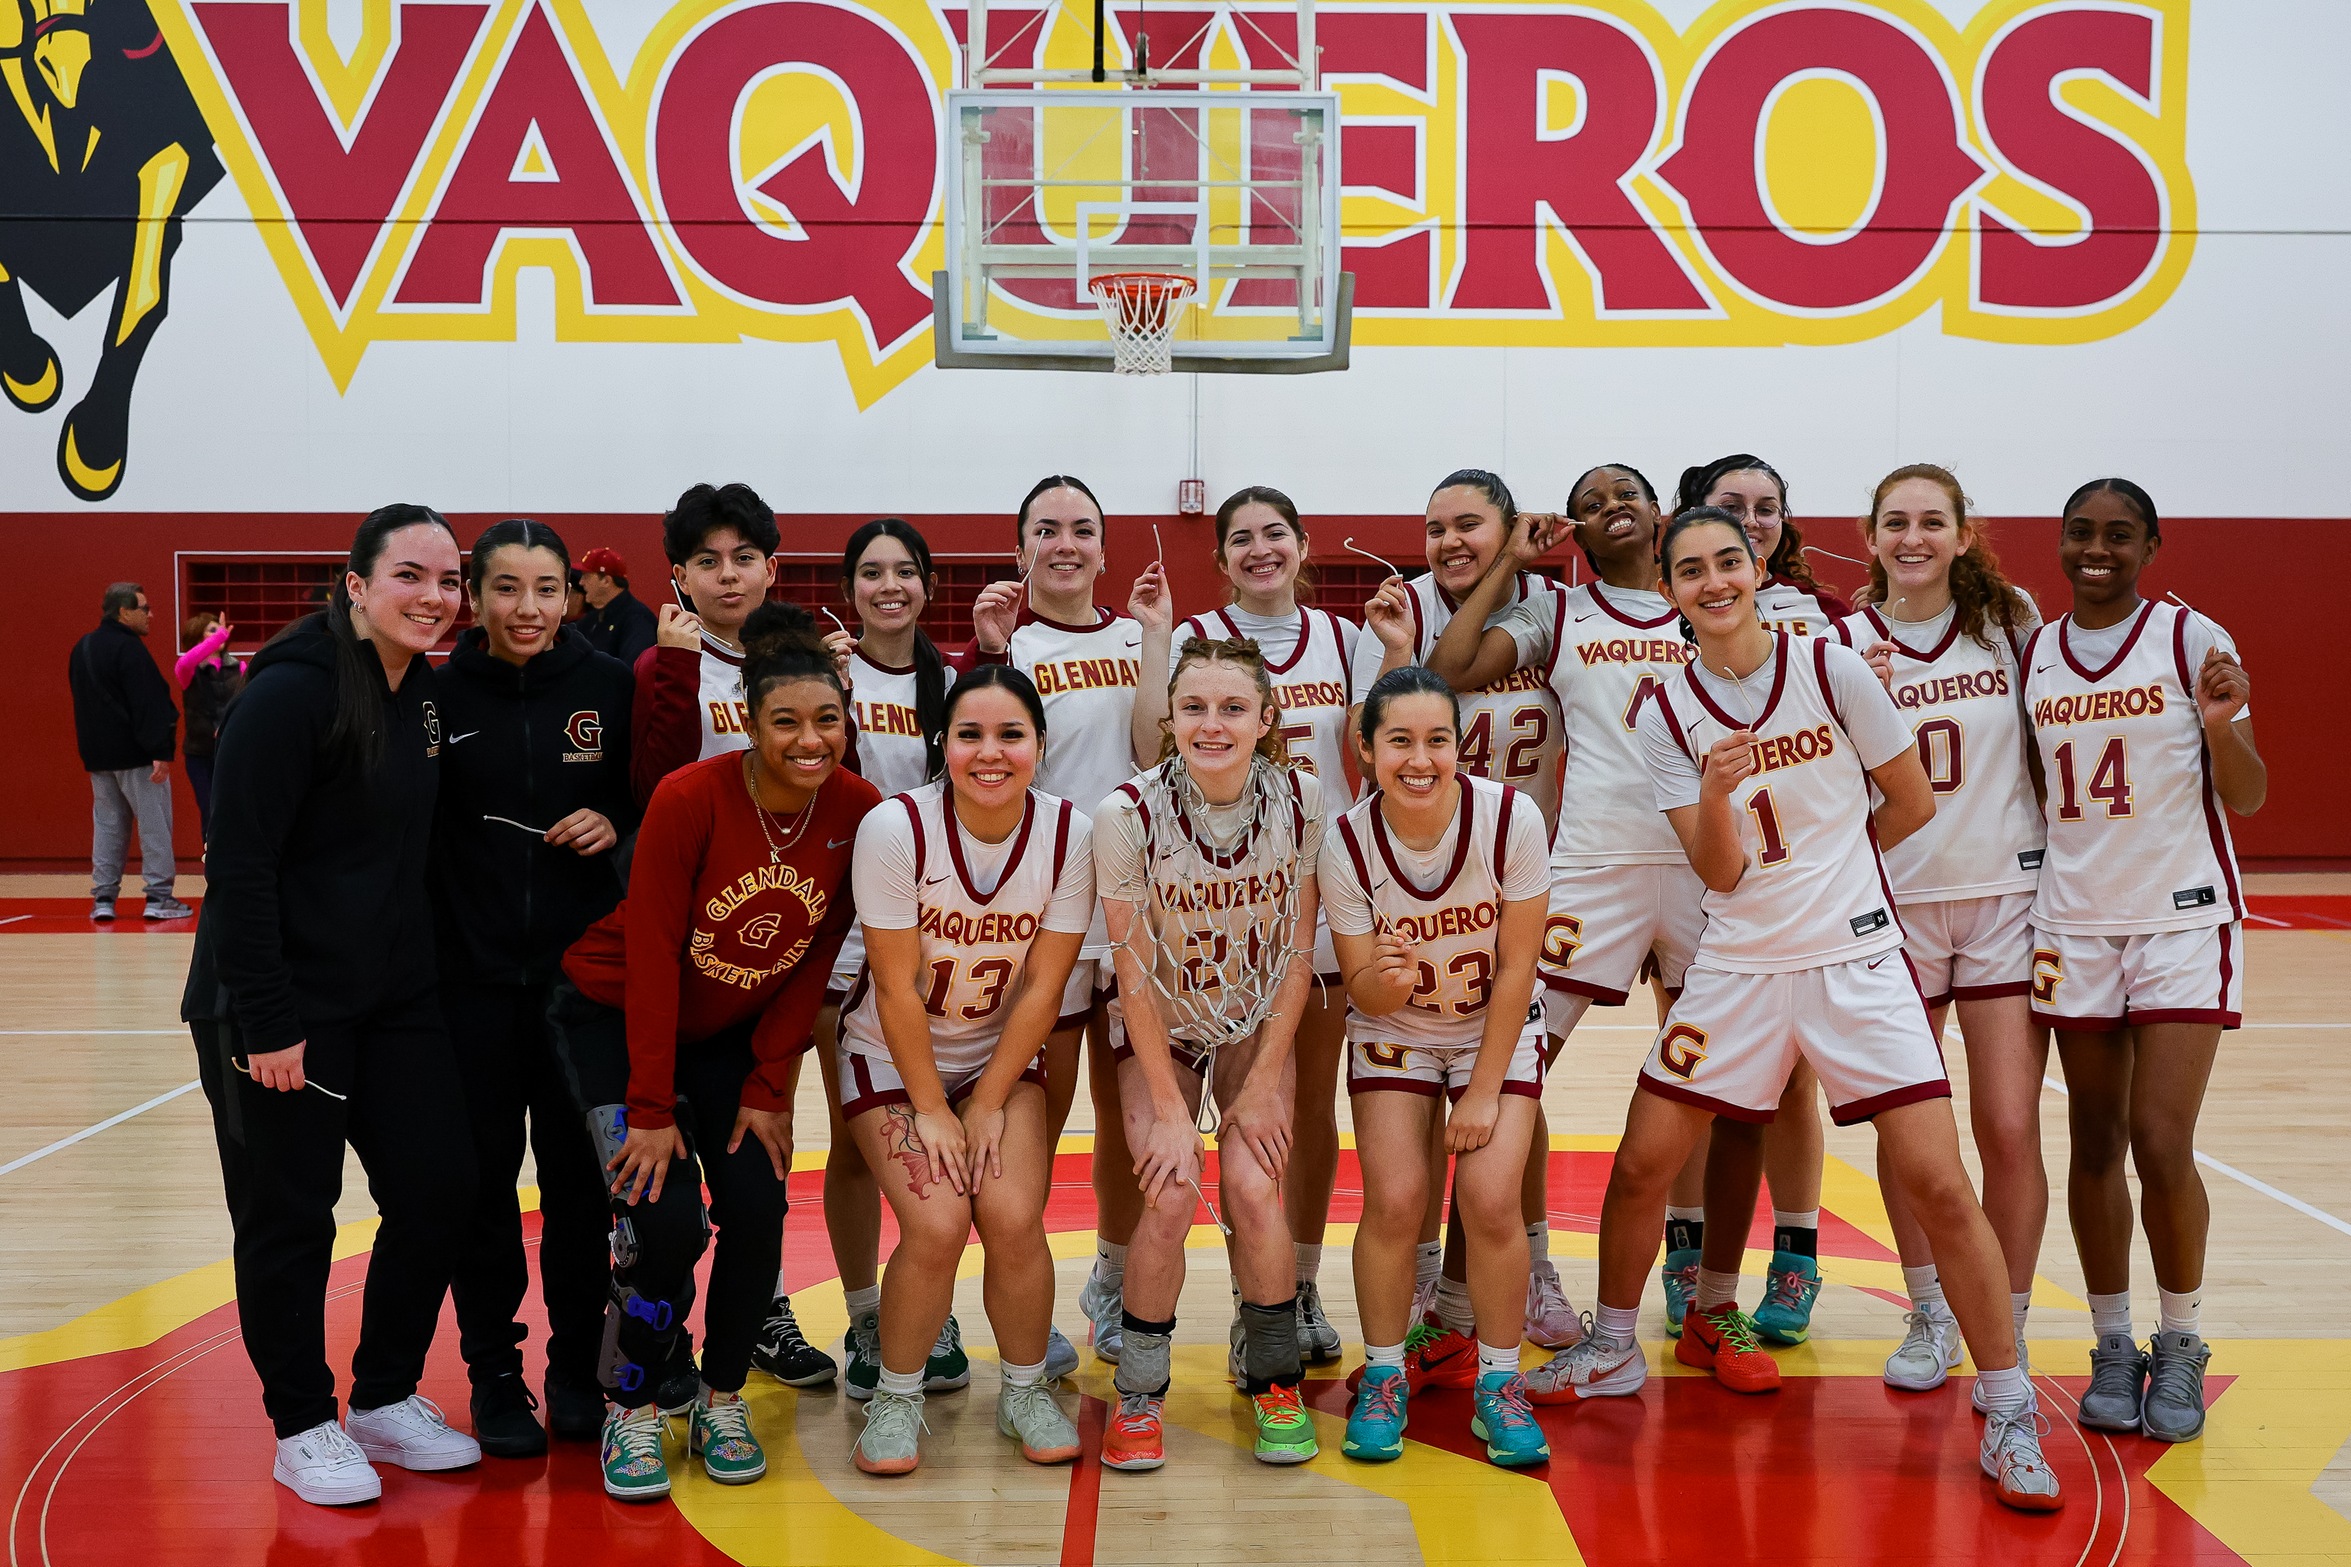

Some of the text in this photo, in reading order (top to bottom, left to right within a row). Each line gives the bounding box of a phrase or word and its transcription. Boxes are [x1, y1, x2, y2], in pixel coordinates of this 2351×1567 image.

[178, 0, 2172, 368] VAQUEROS
[1034, 658, 1140, 696] GLENDA
[1575, 639, 1702, 669] VAQUERO
[1271, 681, 1345, 710] UEROS
[1888, 669, 2010, 711] QUEROS
[2034, 683, 2166, 731] VAQUEROS
[563, 710, 604, 751] G
[856, 701, 923, 738] LEND
[1456, 704, 1550, 781] 42
[1700, 723, 1836, 778] UEROS
[2053, 734, 2135, 823] 14
[1744, 783, 1792, 869] 1
[705, 864, 827, 926] GLENDALE
[1150, 866, 1288, 914] VAQUERO
[737, 913, 781, 949] G
[918, 901, 1044, 948] VAQUERO
[1539, 913, 1584, 969] G
[923, 955, 1018, 1022] 13
[1658, 1021, 1709, 1082] G
